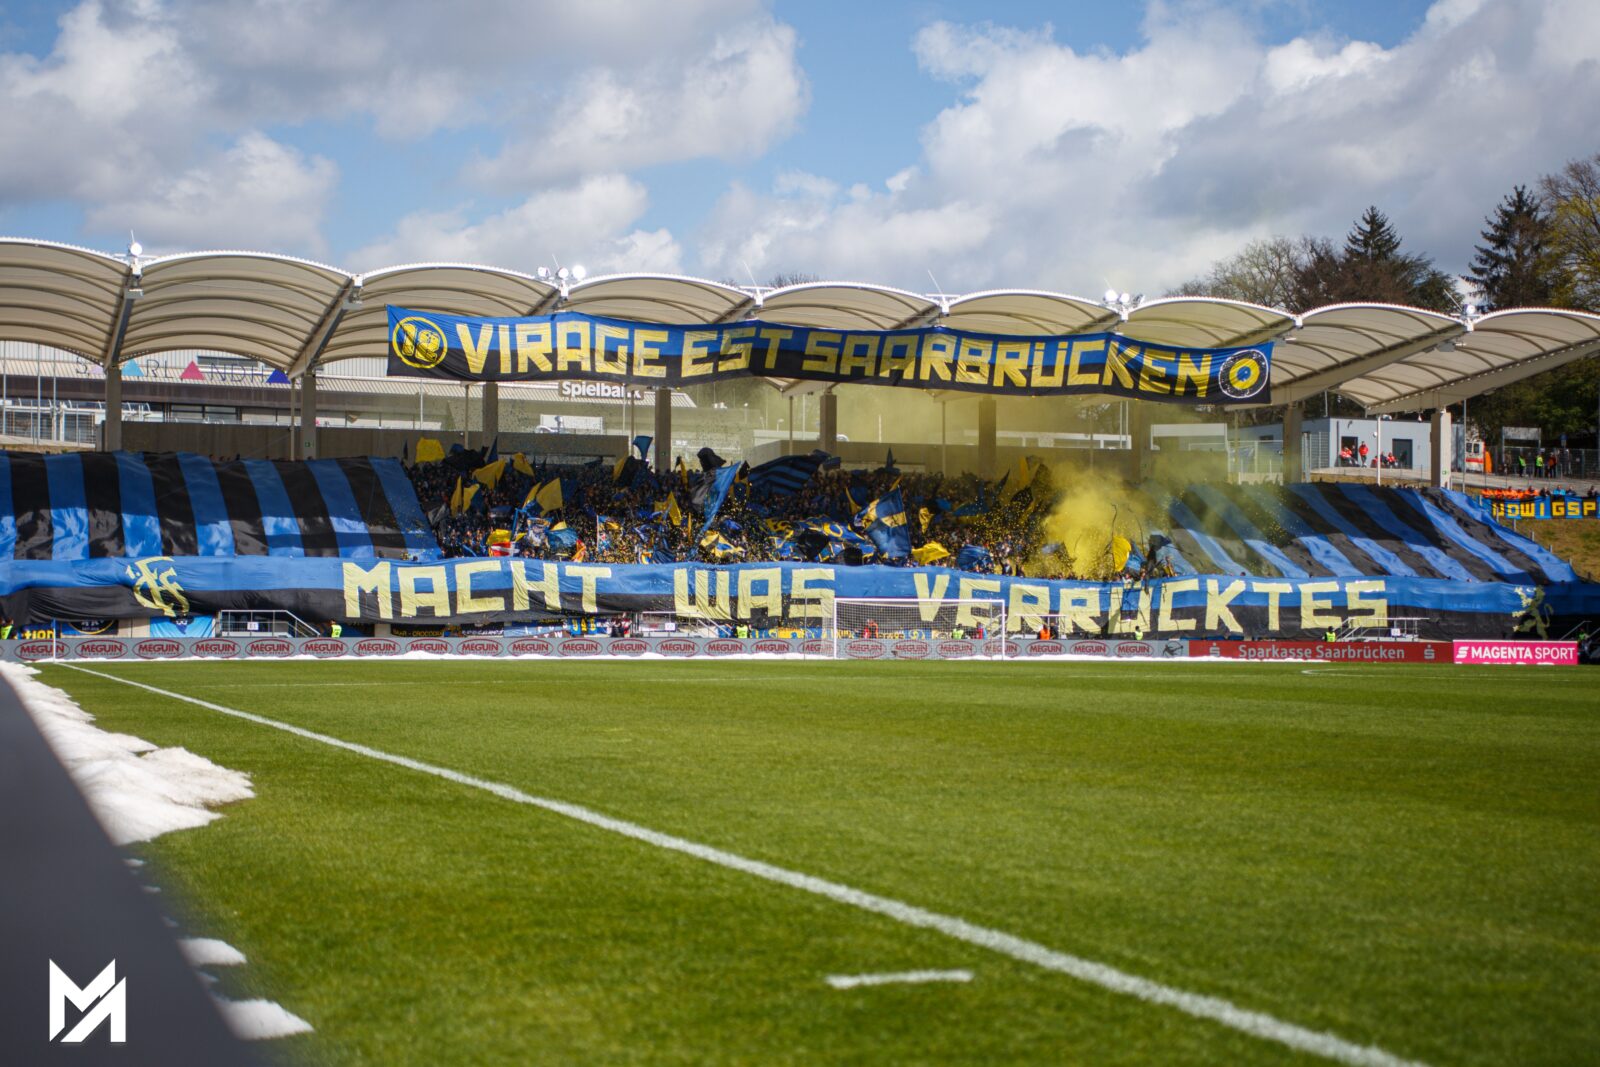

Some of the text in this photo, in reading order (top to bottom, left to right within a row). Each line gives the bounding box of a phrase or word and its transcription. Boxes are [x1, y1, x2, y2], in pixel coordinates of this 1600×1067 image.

[456, 320, 667, 378] VIRAGE
[681, 328, 792, 378] EST
[802, 331, 1213, 398] SAARBRÜCKEN
[342, 560, 612, 620] MACHT
[673, 567, 836, 620] WAS
[1238, 644, 1405, 659] Sparkasse Saarbrücken
[1471, 646, 1575, 660] MAGENTA SPORT
